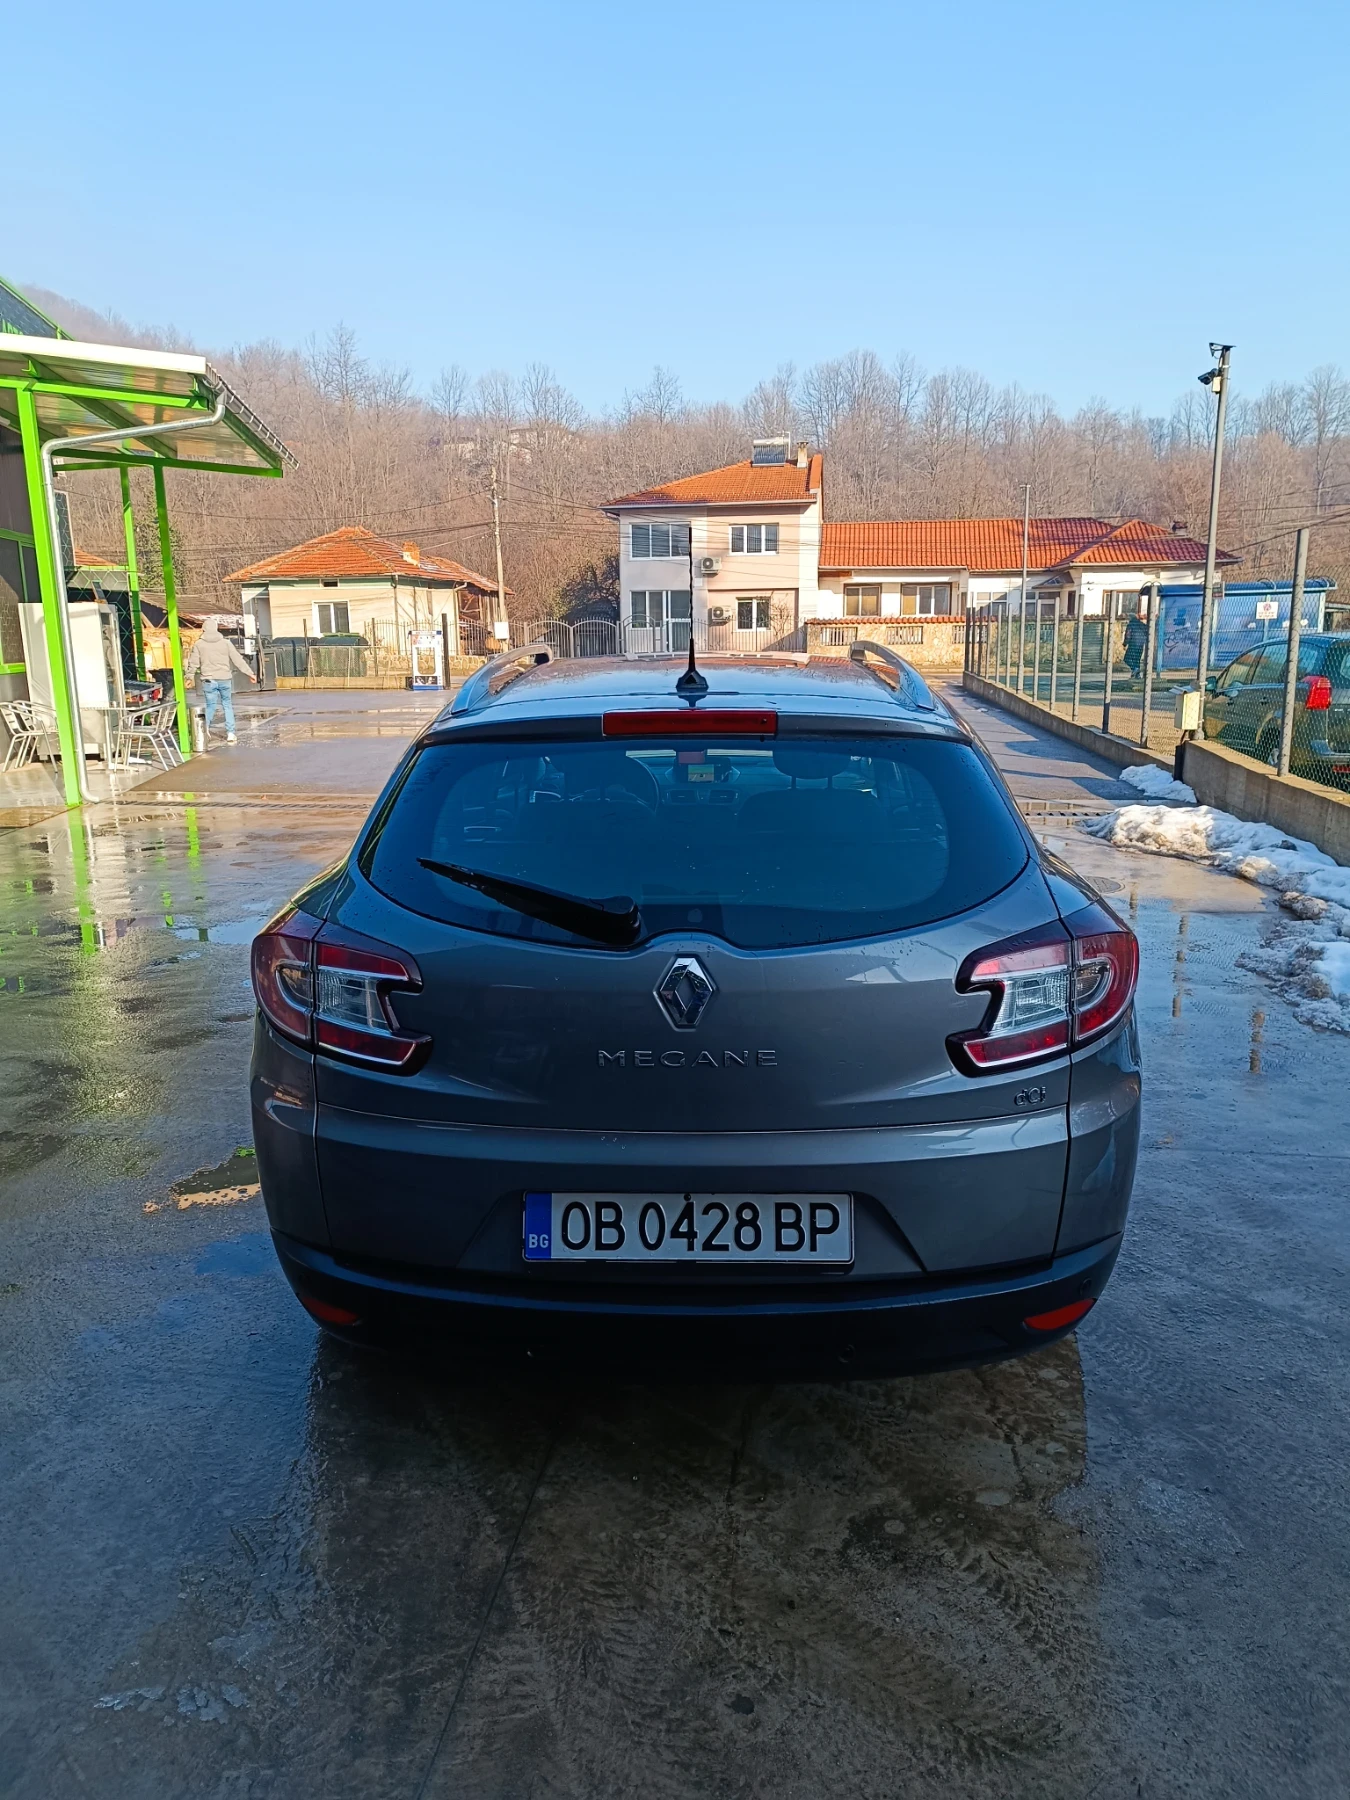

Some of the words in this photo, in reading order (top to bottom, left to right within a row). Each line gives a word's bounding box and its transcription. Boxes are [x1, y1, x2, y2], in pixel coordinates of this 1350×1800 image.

[598, 1049, 778, 1068] MEGANE
[561, 1200, 626, 1252] OB
[638, 1200, 763, 1252] 0428
[773, 1201, 841, 1253] BP
[528, 1233, 549, 1249] BG
